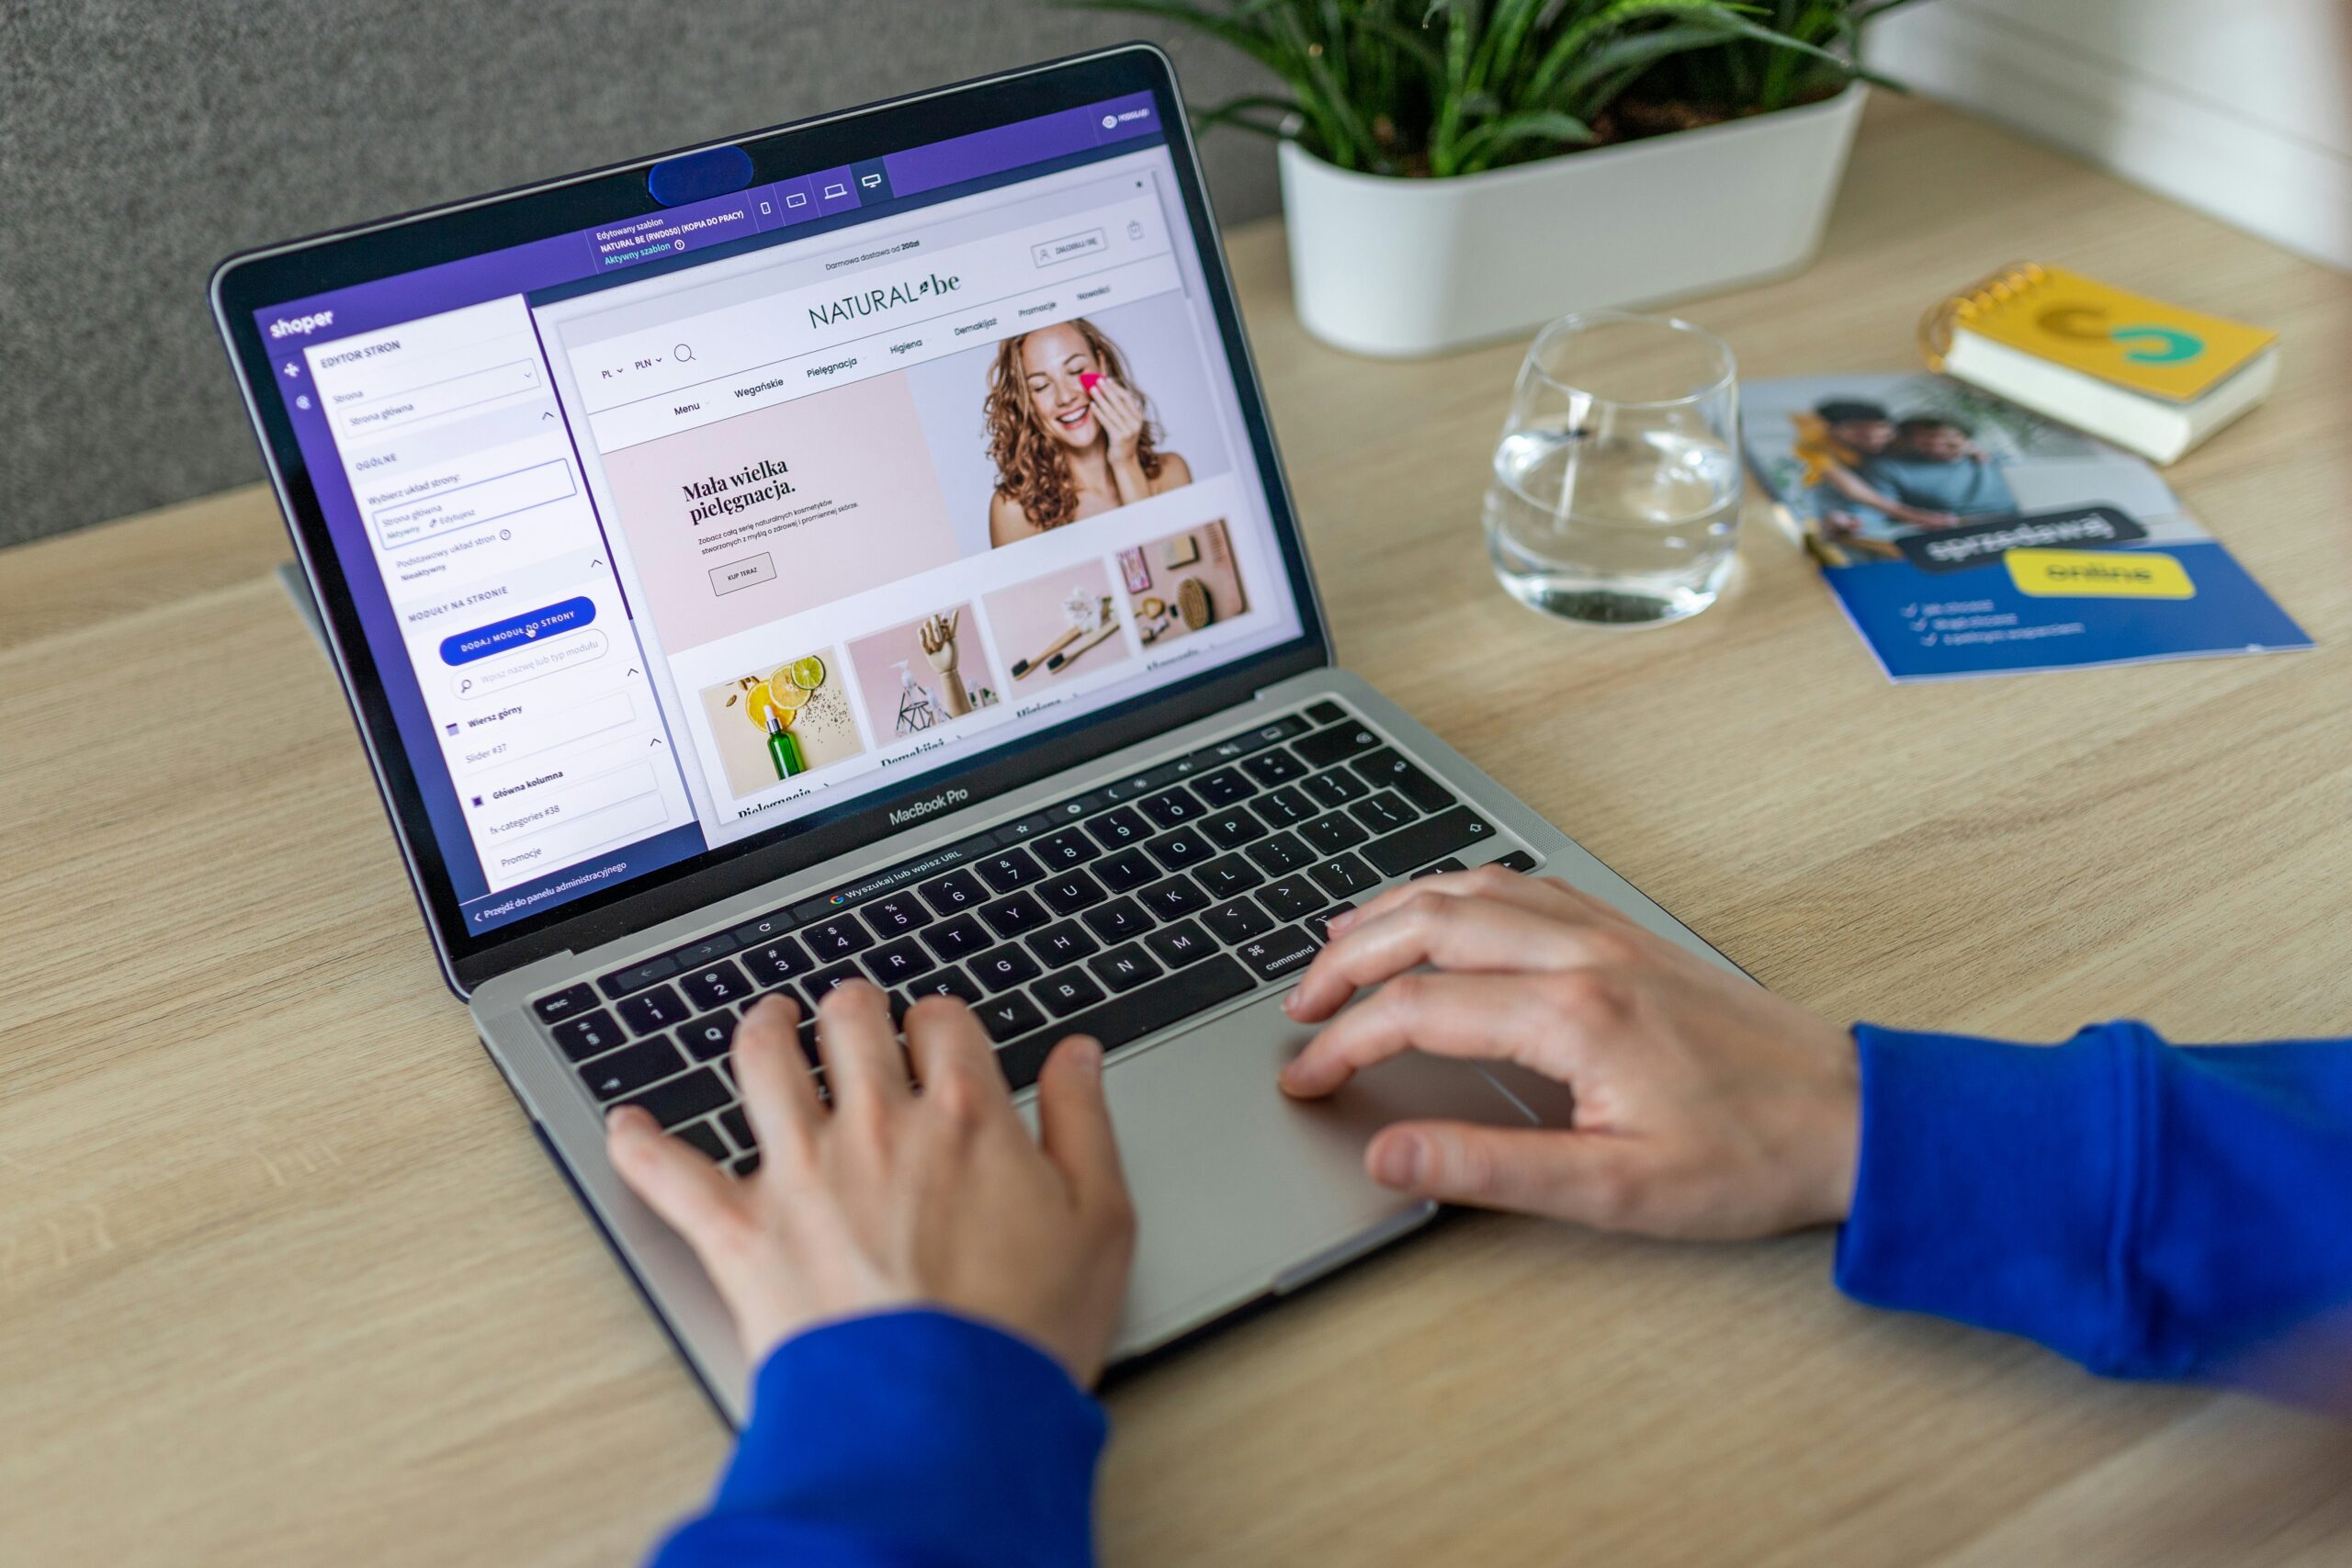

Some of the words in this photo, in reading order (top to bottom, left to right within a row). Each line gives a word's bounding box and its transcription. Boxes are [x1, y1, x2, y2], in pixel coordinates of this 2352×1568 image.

[596, 222, 636, 242] Edytowany
[637, 217, 663, 232] szablon
[600, 237, 635, 254] NATURAL
[635, 234, 645, 243] BE
[682, 219, 707, 235] (KOPIA
[706, 217, 718, 227] DO
[718, 209, 745, 225] PRACY)
[605, 247, 639, 265] Aktywny
[640, 241, 671, 256] szablon
[825, 257, 859, 272] Darmowa
[860, 250, 890, 265] dostawa
[890, 245, 901, 255] od
[1077, 285, 1111, 301] Nowości
[808, 282, 919, 330] NATURAL
[930, 273, 963, 297] be
[1018, 300, 1057, 318] Promocje
[269, 310, 334, 338] shoper
[954, 317, 998, 336] Demakijaż
[321, 350, 362, 368] EDYTOR
[365, 340, 401, 358] STRON
[890, 338, 923, 356] Higiena
[635, 357, 651, 370] PLN
[807, 356, 858, 378] Pielęgnacja
[602, 369, 613, 379] PL
[333, 389, 364, 404] Strona
[734, 378, 785, 400] Wegańskie
[348, 411, 379, 426] Strona
[381, 403, 415, 421] główna
[673, 401, 701, 417] Menu
[356, 453, 397, 472] OGÓLNE
[682, 476, 729, 502] Mała
[729, 458, 789, 488] wielka
[368, 489, 404, 506] Wybierz
[404, 480, 430, 496] układ
[431, 473, 460, 489] strony:
[689, 479, 797, 526] pielęgnacja.
[381, 512, 411, 527] Strona
[412, 504, 443, 521] główna
[439, 509, 476, 525] Edytujesz
[697, 532, 723, 546] Zobacz
[722, 526, 739, 539] całą
[738, 522, 754, 534] serię
[754, 511, 794, 529] naturalnych
[793, 499, 833, 518] kosmetyków
[387, 525, 420, 540] Aktywny
[701, 537, 742, 556] stworzonych
[747, 528, 767, 542] myślą
[773, 520, 799, 534] zdrowej
[801, 506, 838, 526] promiennej
[396, 549, 449, 570] Podstawowy
[449, 539, 474, 554] układ
[474, 534, 497, 546] stron
[401, 563, 447, 581] Nieaktywny
[727, 570, 740, 581] KUP
[739, 567, 758, 578] TERAZ
[408, 603, 449, 623] MODUŁY
[450, 598, 466, 610] NA
[466, 586, 509, 605] STRONIE
[460, 636, 492, 652] DODAJ
[492, 626, 525, 644] MODUŁ
[525, 622, 539, 633] DO
[540, 610, 575, 628] STRONY
[480, 668, 507, 684] Wpisz
[507, 660, 535, 676] nazwę
[535, 654, 550, 666] lub
[549, 649, 565, 664] typ
[566, 640, 599, 657] modułu
[467, 712, 497, 728] Wiersz
[498, 705, 523, 720] górny
[465, 749, 491, 763] Slider
[492, 743, 507, 755] #37
[492, 782, 526, 800] Główna
[526, 771, 564, 788] kolumna
[889, 796, 946, 826] MacBook
[947, 787, 968, 802] Pro
[1170, 806, 1183, 816] 0
[489, 811, 544, 836] fx-categories
[544, 804, 560, 817] #38
[1225, 821, 1237, 832] P
[1117, 827, 1130, 836] 9
[1064, 848, 1077, 858] 8
[1172, 842, 1187, 852] O
[500, 847, 542, 867] Promocje
[845, 874, 895, 899] Wyszukaj
[894, 870, 911, 881] lub
[911, 858, 941, 875] wpisz
[940, 850, 962, 863] URL
[1008, 869, 1018, 881] 7
[1121, 864, 1130, 874] I
[1220, 871, 1235, 880] L
[483, 897, 514, 919] Przejdź
[514, 895, 526, 907] do
[526, 886, 555, 905] panelu
[555, 861, 628, 895] administracyjnego
[952, 891, 965, 901] 6
[1062, 885, 1078, 897] U
[1166, 890, 1182, 903] K
[894, 913, 908, 924] 5
[1006, 908, 1020, 919] Y
[1116, 913, 1125, 924] J
[837, 937, 849, 948] 4
[948, 931, 962, 942] T
[1054, 936, 1070, 949] H
[1172, 936, 1192, 949] M
[775, 960, 789, 971] 3
[890, 954, 907, 967] R
[1265, 944, 1316, 971] command
[997, 960, 1012, 972] G
[1116, 960, 1134, 973] N
[713, 984, 729, 996] 2
[936, 984, 950, 996] F
[1059, 985, 1075, 997] B
[546, 998, 569, 1010] esc
[650, 1009, 663, 1020] 1
[999, 1008, 1014, 1021] V
[705, 1027, 724, 1041] Q
